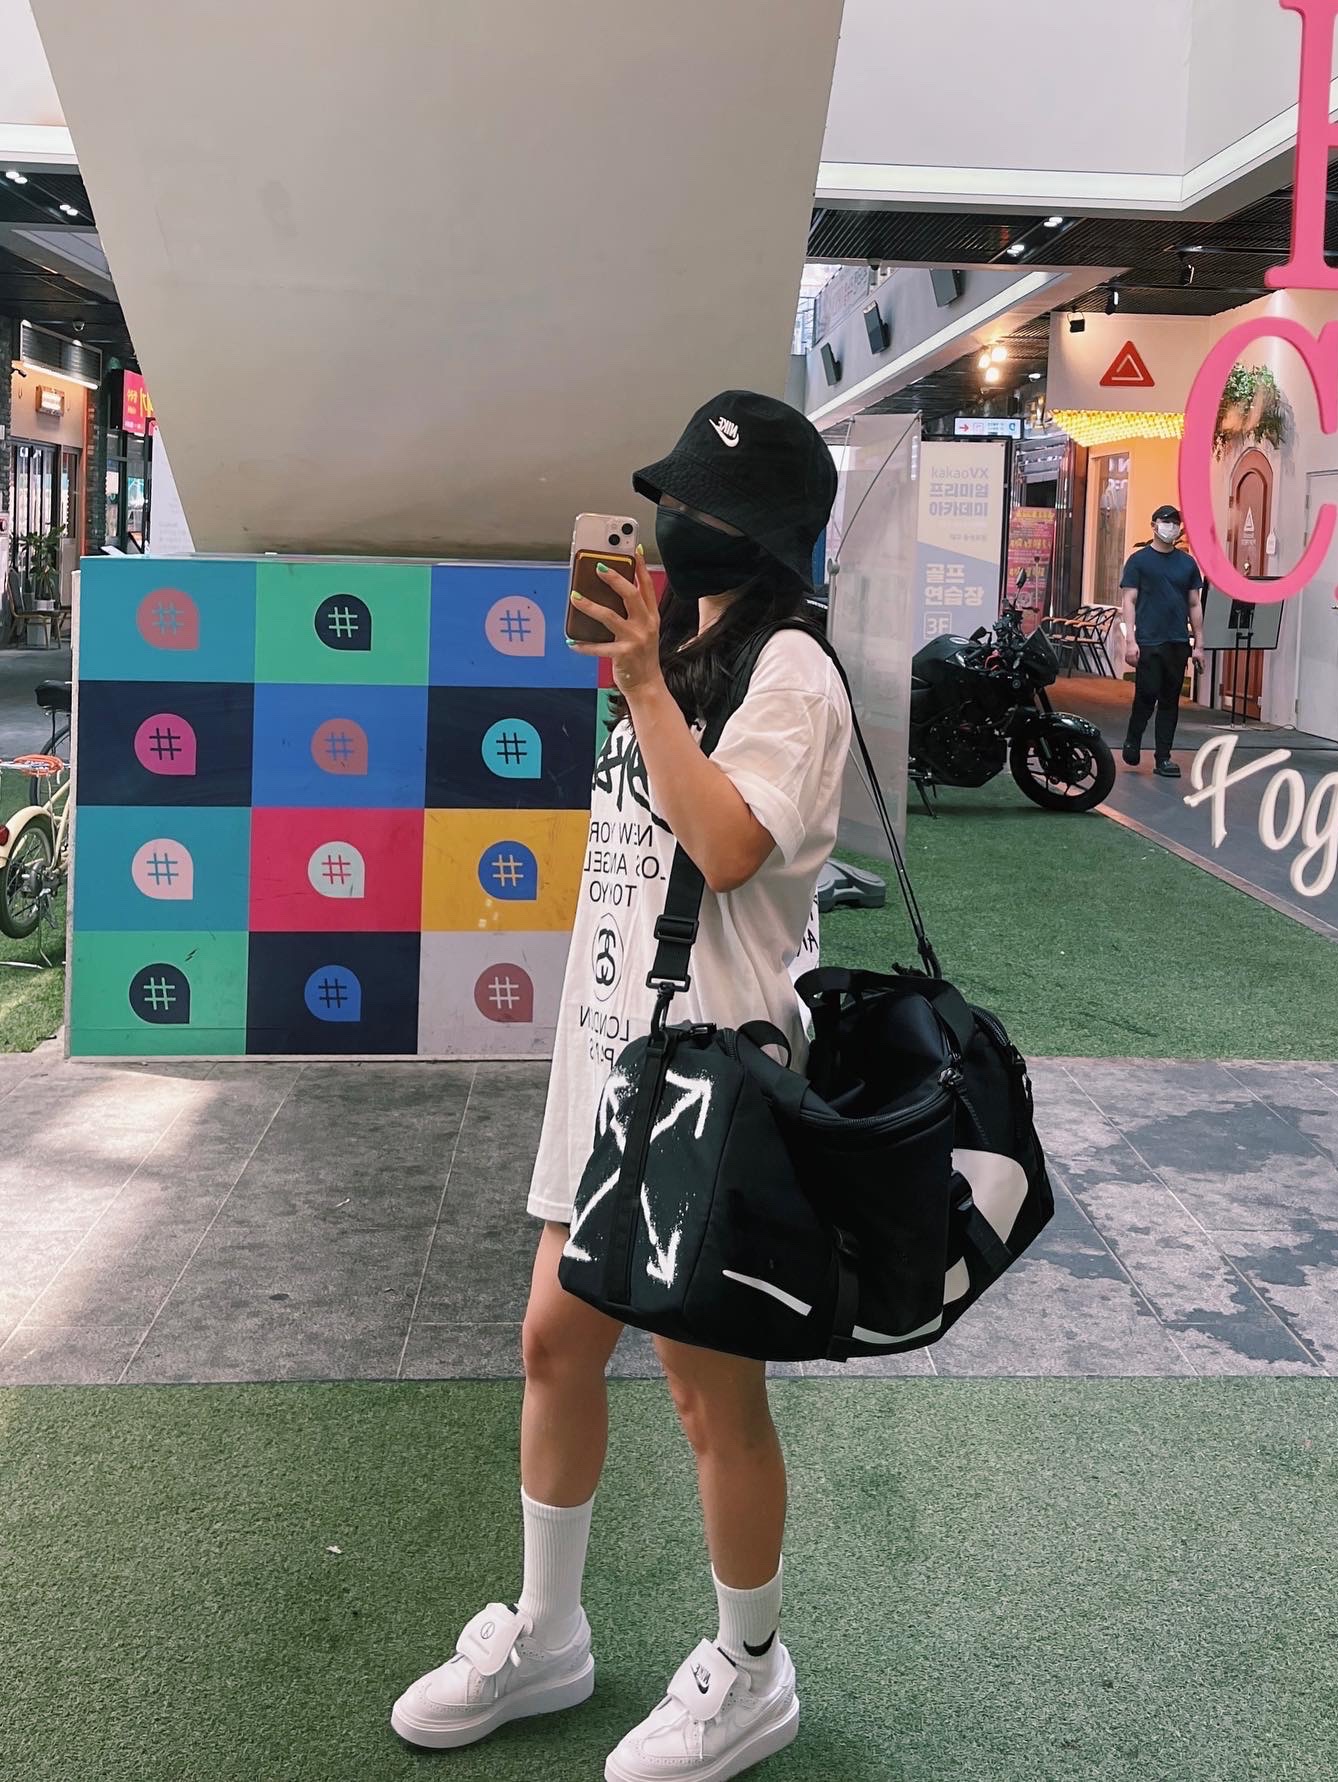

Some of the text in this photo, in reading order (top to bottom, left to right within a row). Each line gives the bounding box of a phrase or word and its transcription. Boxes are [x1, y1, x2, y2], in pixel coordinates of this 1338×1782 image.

[931, 466, 989, 479] kakaoVX
[929, 501, 989, 517] 아카데미
[926, 563, 965, 583] 골프
[925, 586, 984, 606] 연습장
[926, 617, 949, 635] 3F
